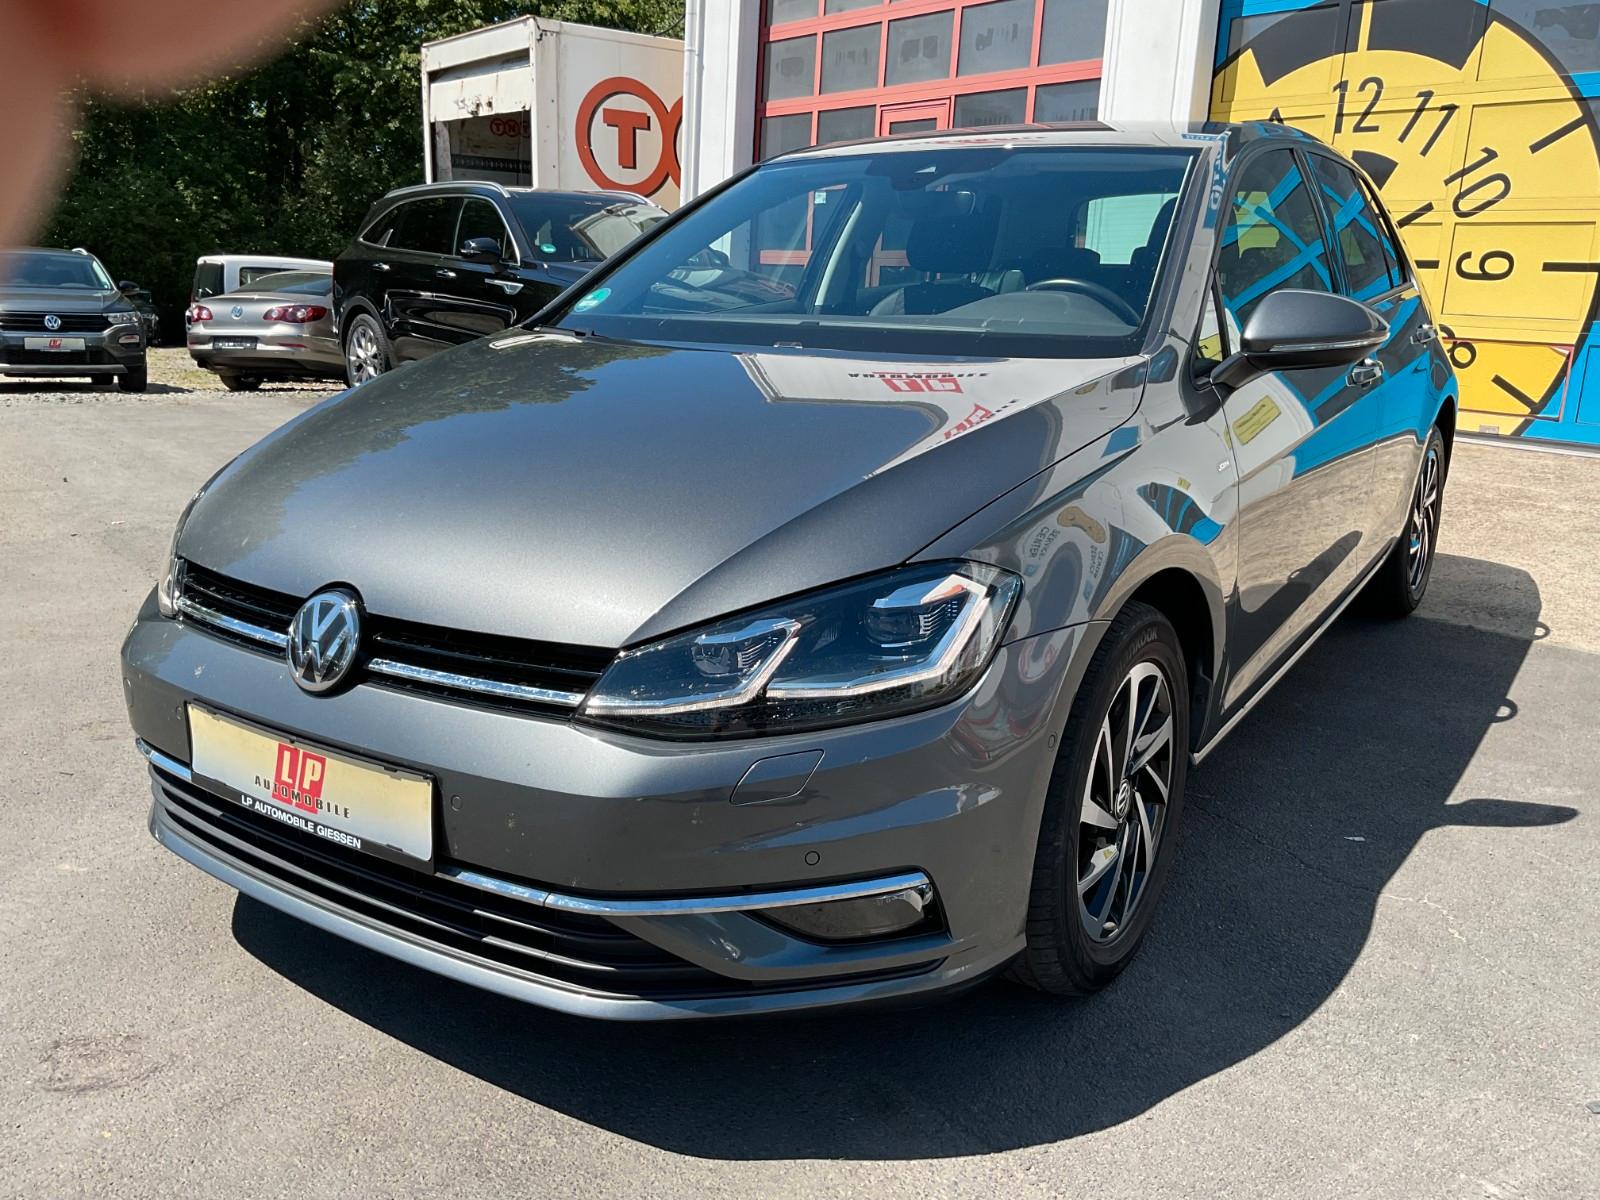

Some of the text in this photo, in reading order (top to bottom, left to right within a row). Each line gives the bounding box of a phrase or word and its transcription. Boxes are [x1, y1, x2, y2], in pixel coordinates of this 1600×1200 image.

[1332, 76, 1385, 135] 12
[1398, 89, 1460, 157] 11
[1444, 146, 1512, 219] 10
[1456, 250, 1515, 282] 9
[44, 314, 61, 330] VW
[286, 590, 360, 692] VW
[253, 774, 351, 819] AUTOMOBILE
[277, 745, 325, 794] LP
[241, 793, 362, 850] LP AUTOMOBILE GIESSEN
